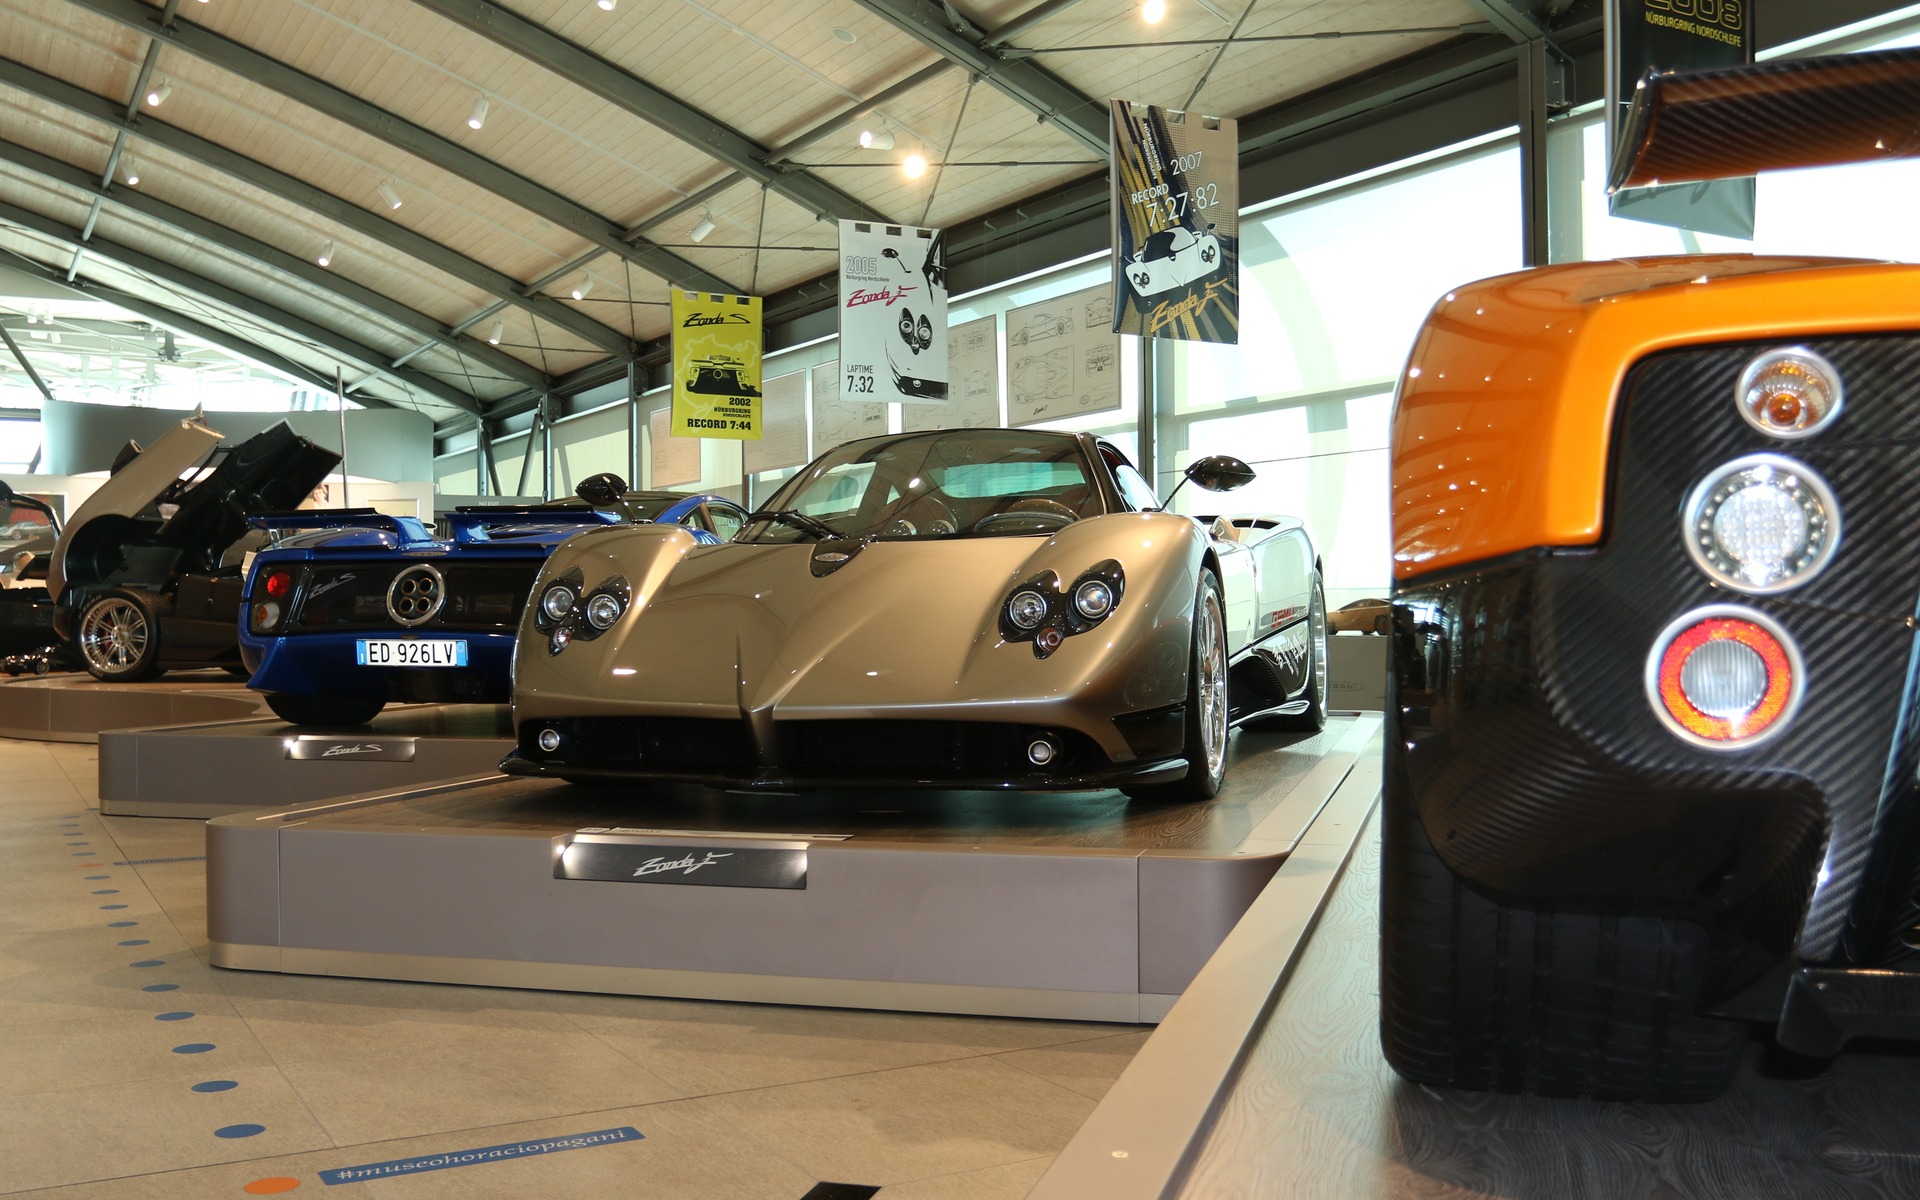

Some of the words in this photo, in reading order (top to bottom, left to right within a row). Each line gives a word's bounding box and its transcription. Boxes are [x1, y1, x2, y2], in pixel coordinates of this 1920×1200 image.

[1645, 11, 1696, 34] NÜRBURGRING
[1696, 25, 1742, 47] NORDSCHLEIFE
[1170, 151, 1203, 176] 2007
[1131, 183, 1169, 205] RECORD
[1146, 183, 1220, 228] 7:27:82
[845, 255, 878, 275] 2005
[846, 285, 891, 308] Zonda
[682, 312, 725, 328] Zonda
[1150, 288, 1199, 334] Zonda
[846, 364, 874, 374] LAPTIME
[846, 375, 875, 393] 7:32
[729, 397, 752, 406] 2002
[687, 418, 727, 430] RECORD
[730, 420, 752, 431] 7:44
[369, 643, 391, 664] ED
[400, 644, 454, 664] 926LV
[322, 744, 361, 757] Zonda
[633, 853, 694, 877] Zonda
[336, 1129, 628, 1181] #museohoraciopagani
